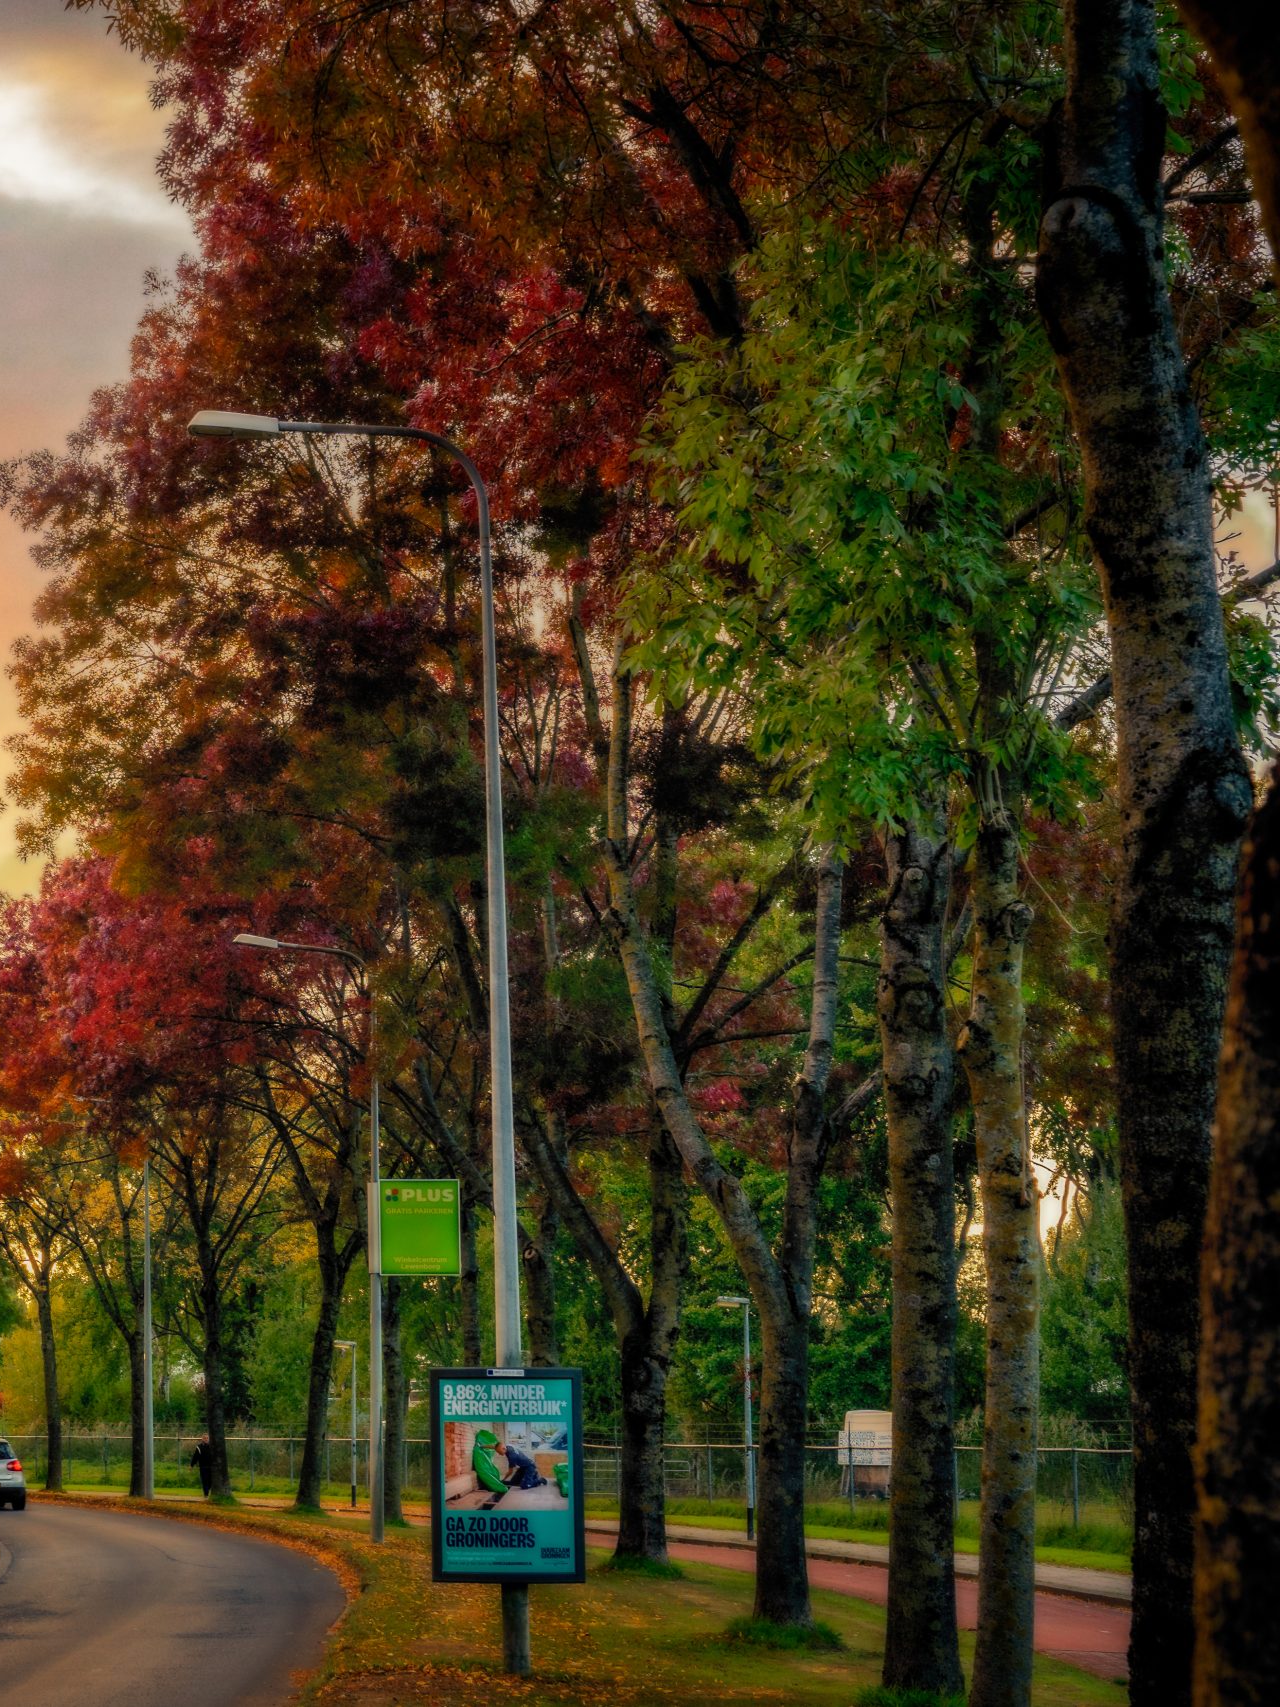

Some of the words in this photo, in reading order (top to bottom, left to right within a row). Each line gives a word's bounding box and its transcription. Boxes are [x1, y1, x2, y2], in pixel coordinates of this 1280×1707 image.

[402, 1189, 454, 1201] PLUS
[491, 1384, 545, 1400] MINDER
[446, 1516, 465, 1532] GA
[468, 1516, 487, 1532] ZO
[489, 1517, 529, 1533] DOOR
[446, 1532, 536, 1549] GRONINGERS
